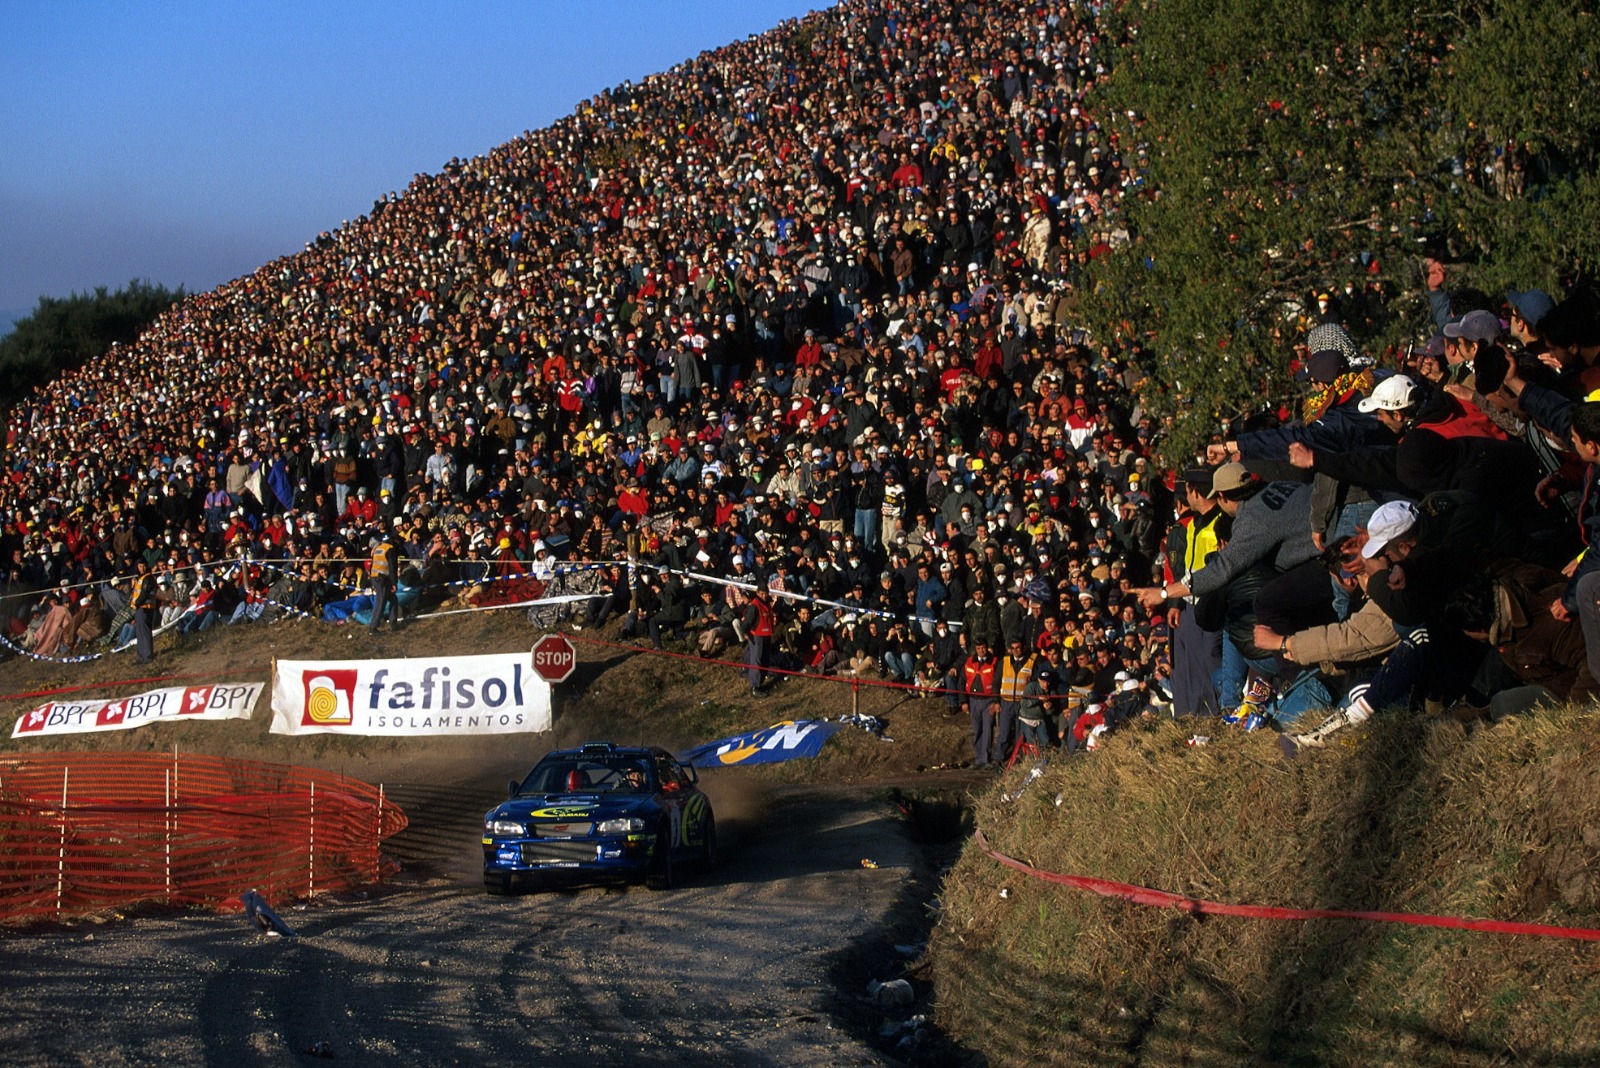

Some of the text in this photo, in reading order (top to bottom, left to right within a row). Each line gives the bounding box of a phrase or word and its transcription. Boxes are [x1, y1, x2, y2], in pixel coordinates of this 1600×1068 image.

[536, 651, 571, 666] STOP
[368, 663, 524, 710] fafisol
[48, 687, 257, 726] BPI BPI BPI
[368, 713, 524, 728] ISOLAMENTOS
